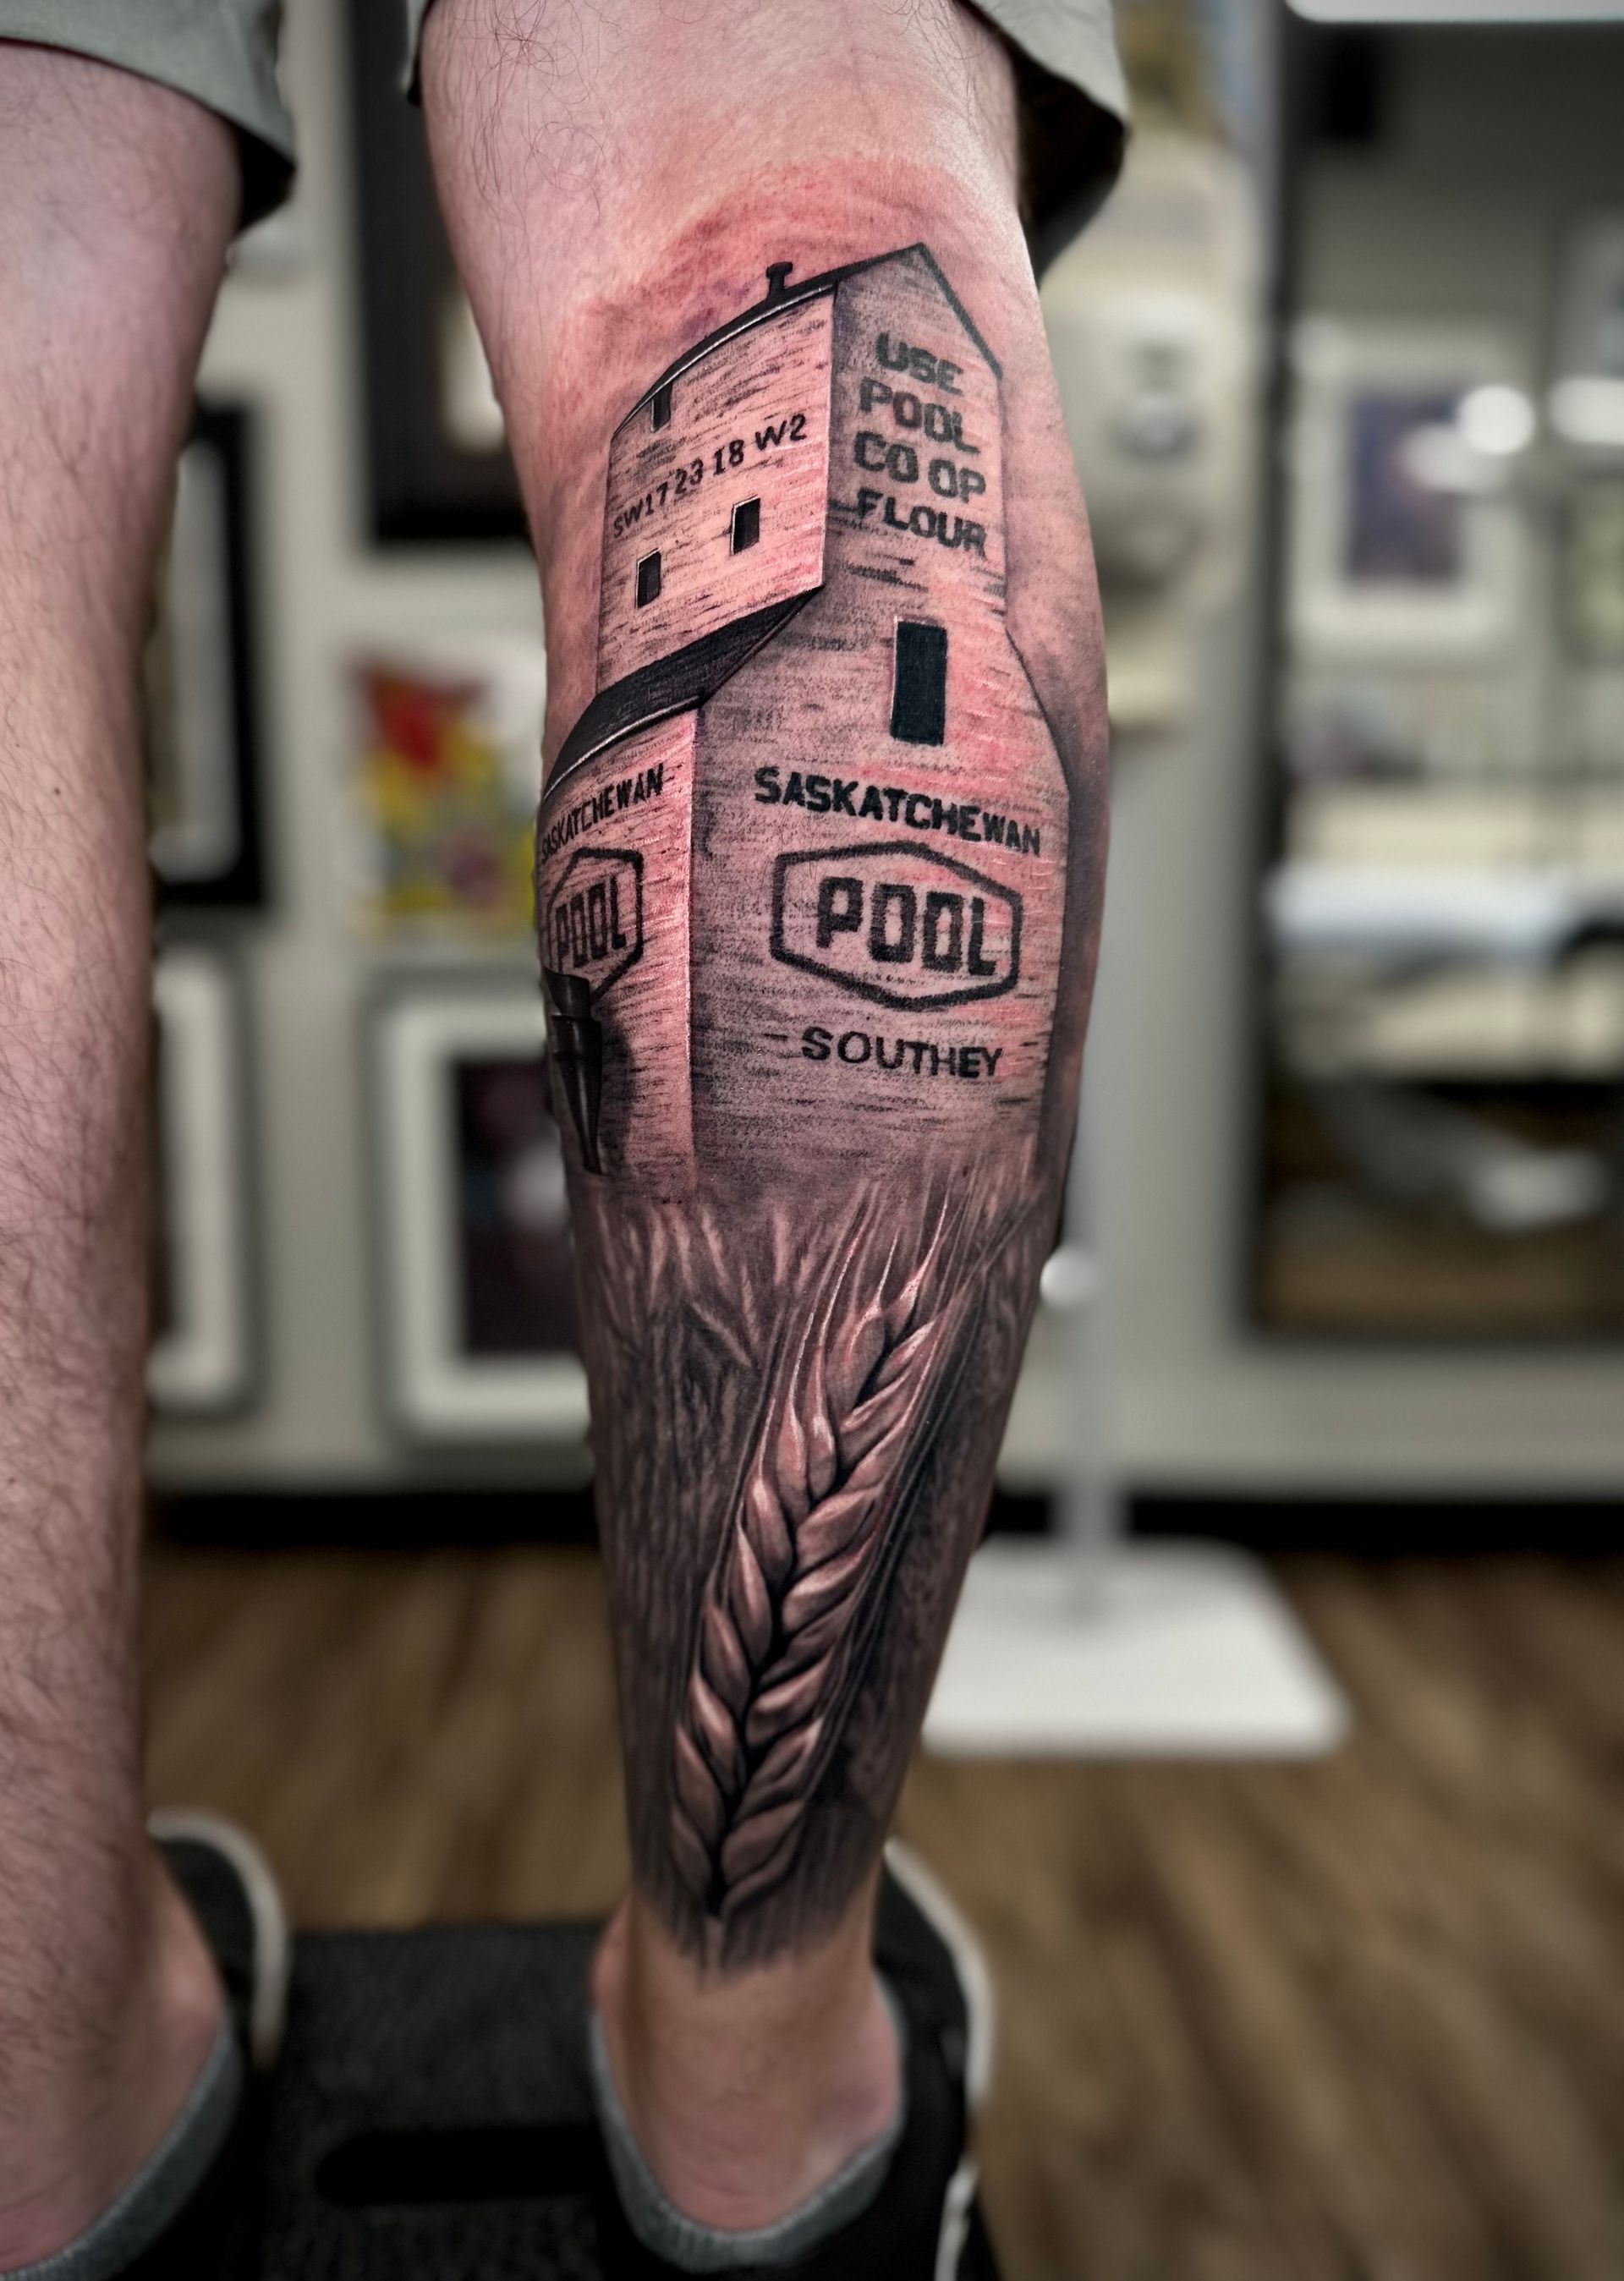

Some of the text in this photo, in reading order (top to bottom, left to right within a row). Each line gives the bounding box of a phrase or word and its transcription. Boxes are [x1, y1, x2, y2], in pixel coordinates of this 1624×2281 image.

[875, 332, 963, 396] USE
[754, 413, 807, 451] W2
[859, 376, 981, 454] POOL
[857, 487, 987, 559] FLOUR
[540, 762, 663, 863] SASKATCHEWAN
[754, 765, 1040, 857] SASKATCHEWAN
[555, 874, 627, 973] POOL
[815, 875, 997, 975] POOL
[801, 1026, 1003, 1078] SOUTHEY
